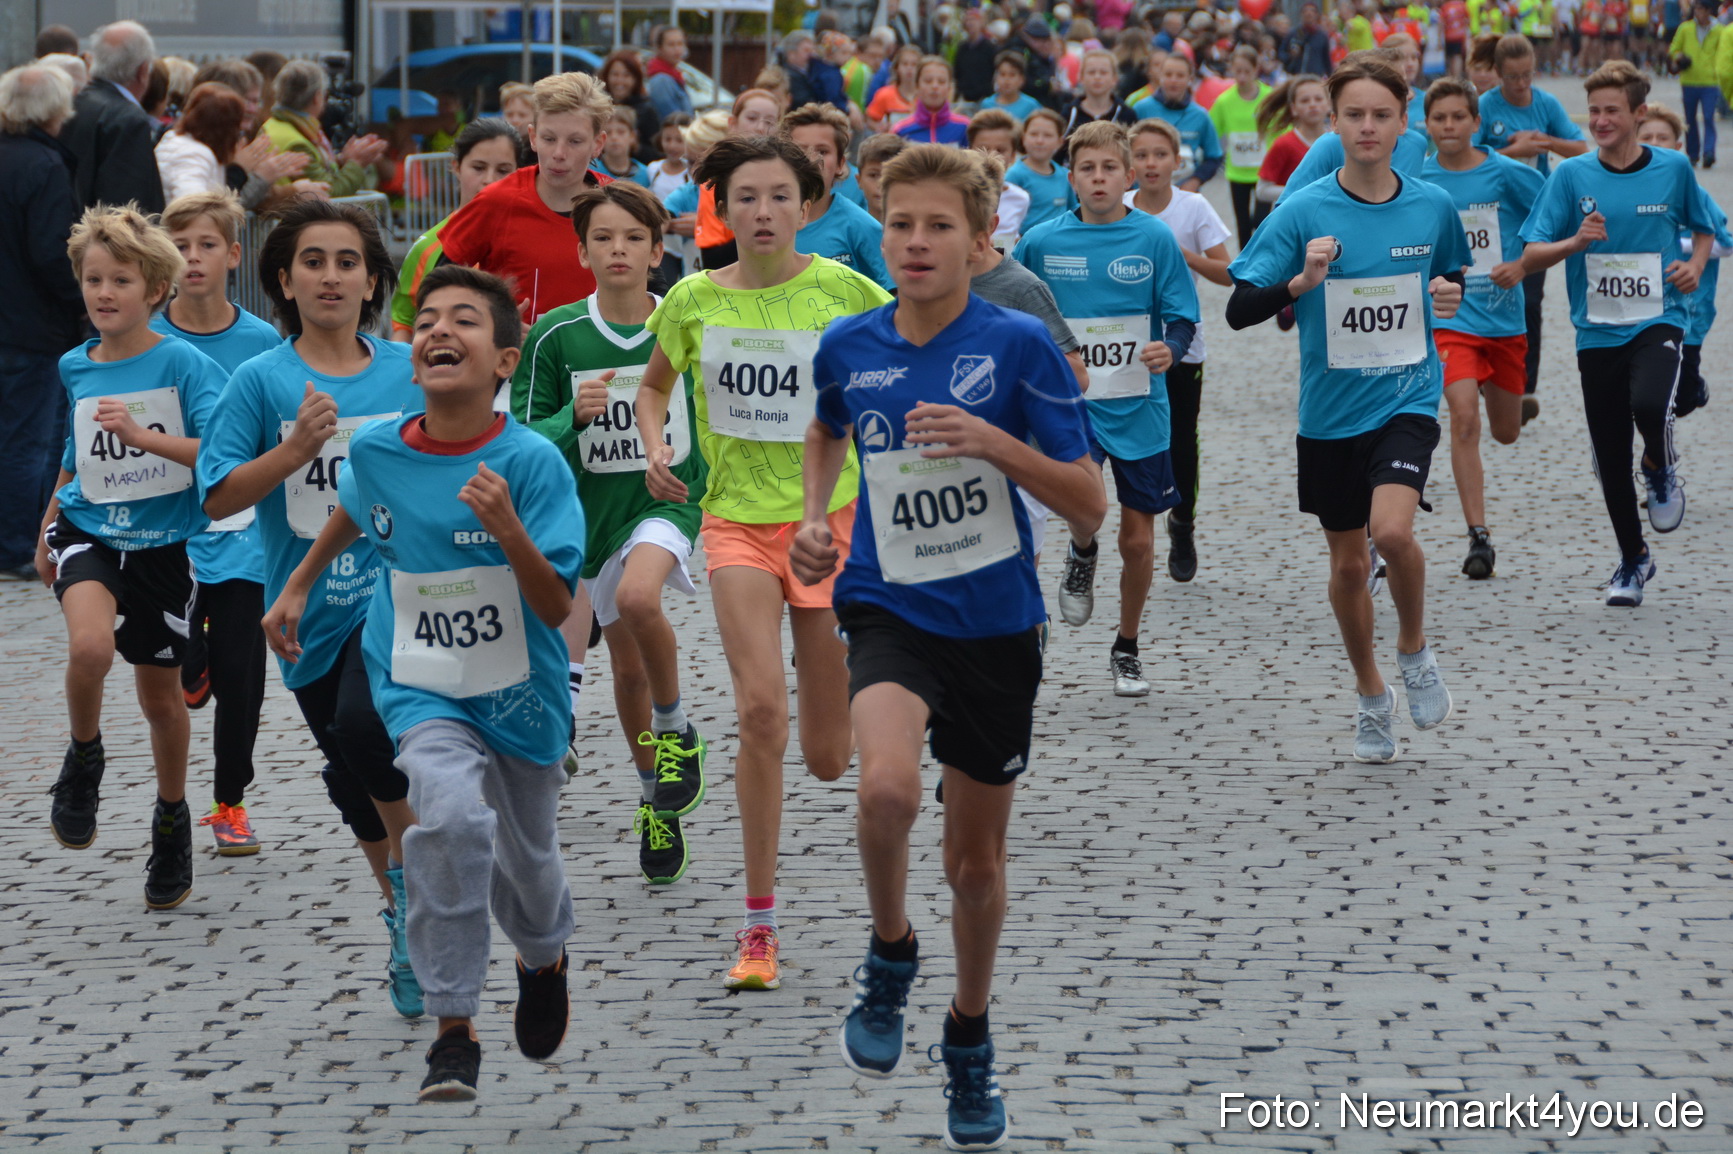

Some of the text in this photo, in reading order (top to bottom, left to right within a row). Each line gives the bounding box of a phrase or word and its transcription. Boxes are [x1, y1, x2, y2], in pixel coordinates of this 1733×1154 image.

[1391, 244, 1431, 257] BOCK
[1363, 284, 1395, 294] BOCK
[1597, 277, 1650, 298] 4036
[1342, 303, 1409, 333] 4097
[743, 339, 784, 350] BOCK
[1080, 341, 1137, 368] 4037
[957, 359, 975, 378] FSV
[718, 362, 800, 398] 4004
[126, 402, 146, 412] CK
[729, 405, 789, 424] Luca Ronja
[104, 463, 166, 489] MARVIN
[1402, 462, 1420, 473] JAKO
[892, 476, 988, 531] 4005
[106, 505, 132, 527] 18.
[98, 524, 165, 540] Neumarkter
[915, 533, 982, 559] Alexander
[429, 580, 477, 596] BOCK
[414, 604, 503, 649] 4033
